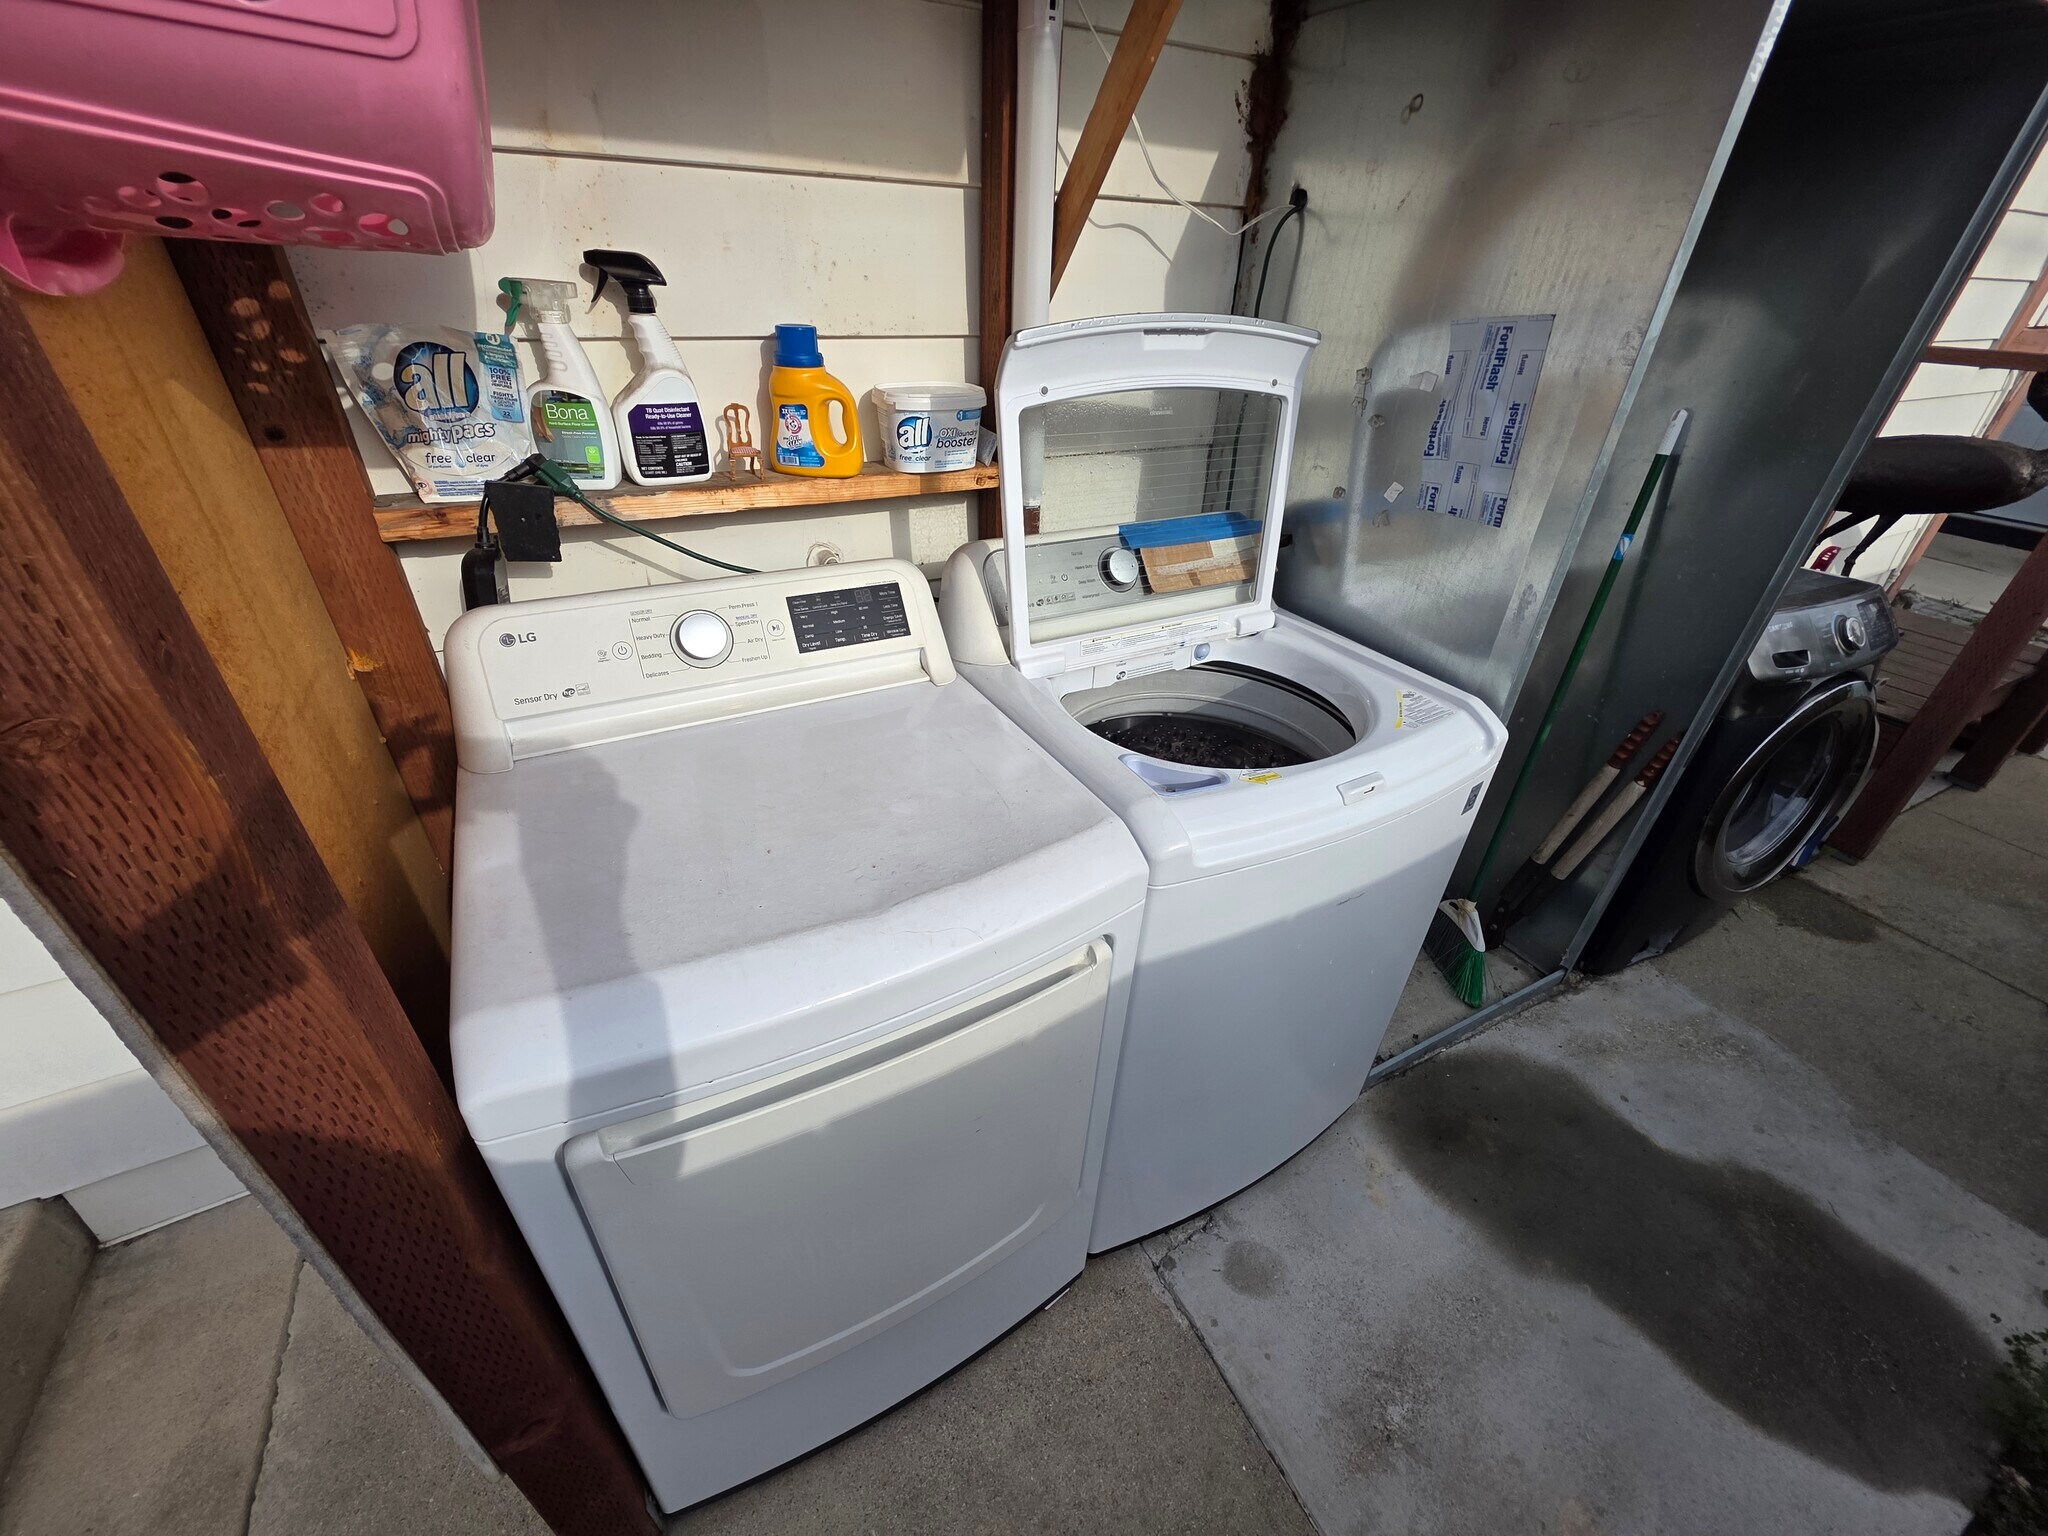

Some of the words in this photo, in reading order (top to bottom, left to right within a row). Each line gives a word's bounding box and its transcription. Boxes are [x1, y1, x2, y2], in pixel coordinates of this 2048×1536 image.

[1486, 326, 1513, 392] FortiFlash
[489, 367, 511, 376] 100%
[401, 351, 466, 411] all
[490, 374, 512, 382] FREE
[492, 390, 514, 398] FIGHTS
[545, 403, 589, 420] Bona
[407, 427, 451, 445] mighty
[451, 422, 496, 444] pacs
[898, 417, 930, 448] all
[940, 428, 957, 437] OXI
[1495, 401, 1521, 464] FortiFlash
[936, 437, 976, 448] booster
[425, 452, 452, 463] free
[466, 453, 496, 463] clear
[518, 632, 537, 643] LG
[641, 652, 662, 660] Bedding
[645, 670, 669, 678] Delicates
[514, 695, 542, 706] Sensor
[543, 692, 558, 701] Dry
